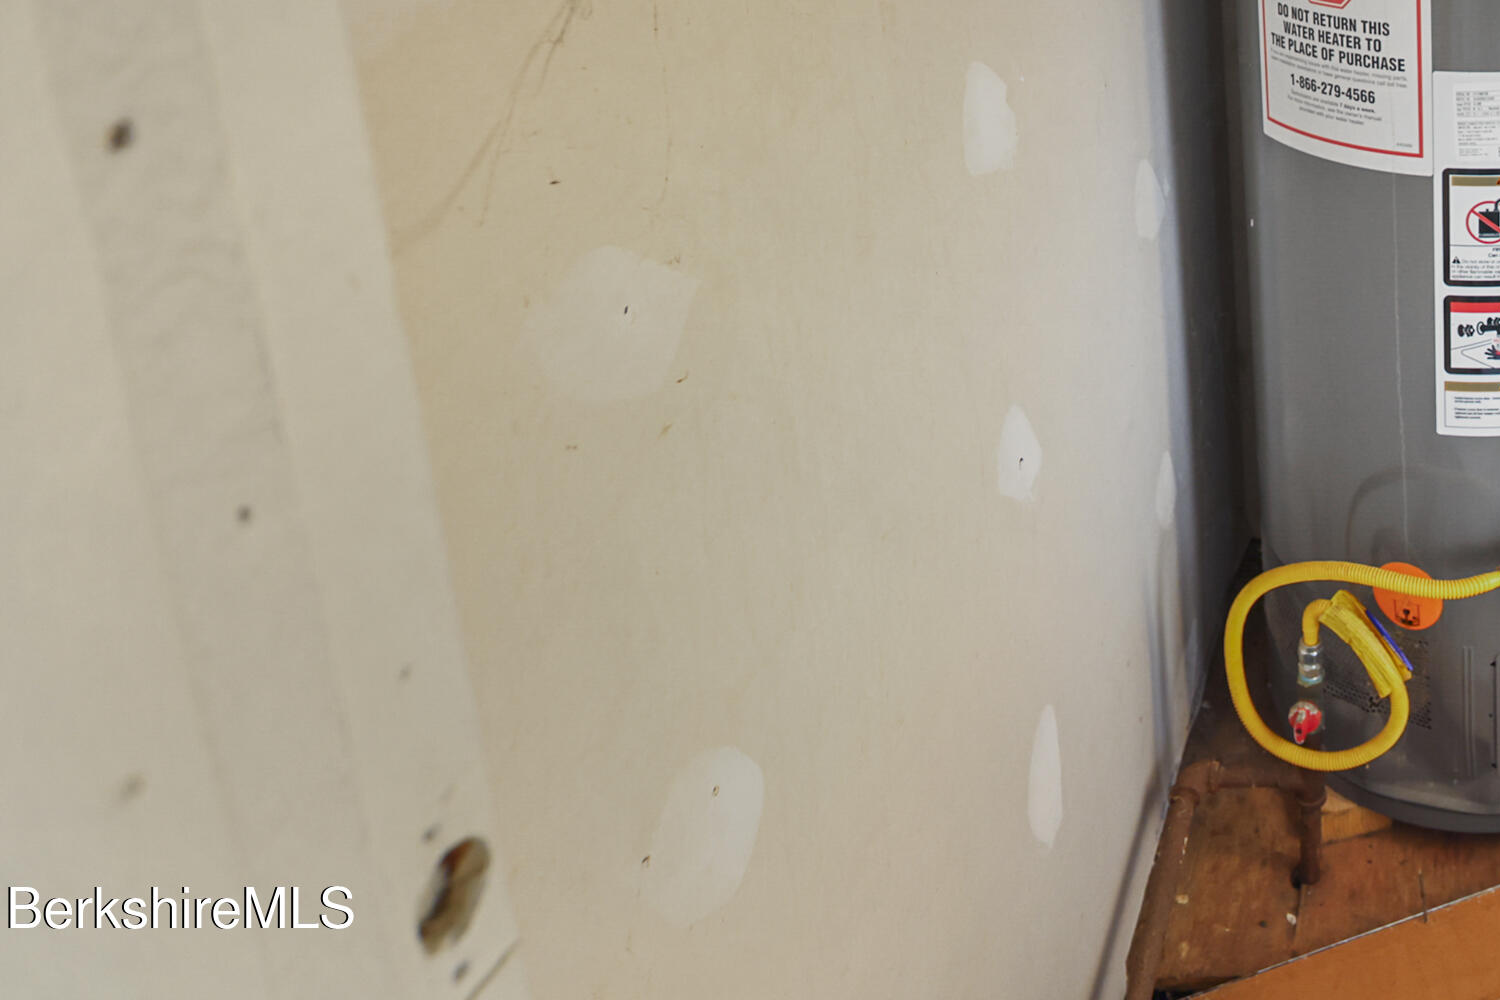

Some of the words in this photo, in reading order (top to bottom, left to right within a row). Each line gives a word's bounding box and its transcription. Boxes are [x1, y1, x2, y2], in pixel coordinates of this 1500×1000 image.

[1277, 2, 1288, 17] DO
[1291, 6, 1310, 22] NOT
[1313, 12, 1357, 32] RETURN
[1361, 20, 1390, 36] THIS
[1271, 32, 1286, 49] THE
[1288, 37, 1318, 59] PLACE
[1321, 47, 1335, 61] OF
[1339, 50, 1405, 72] PURCHASE
[1283, 20, 1315, 41] WATER
[1318, 30, 1361, 50] HEATER
[1366, 38, 1382, 52] TO
[1290, 73, 1376, 104] 1-866-279-4566
